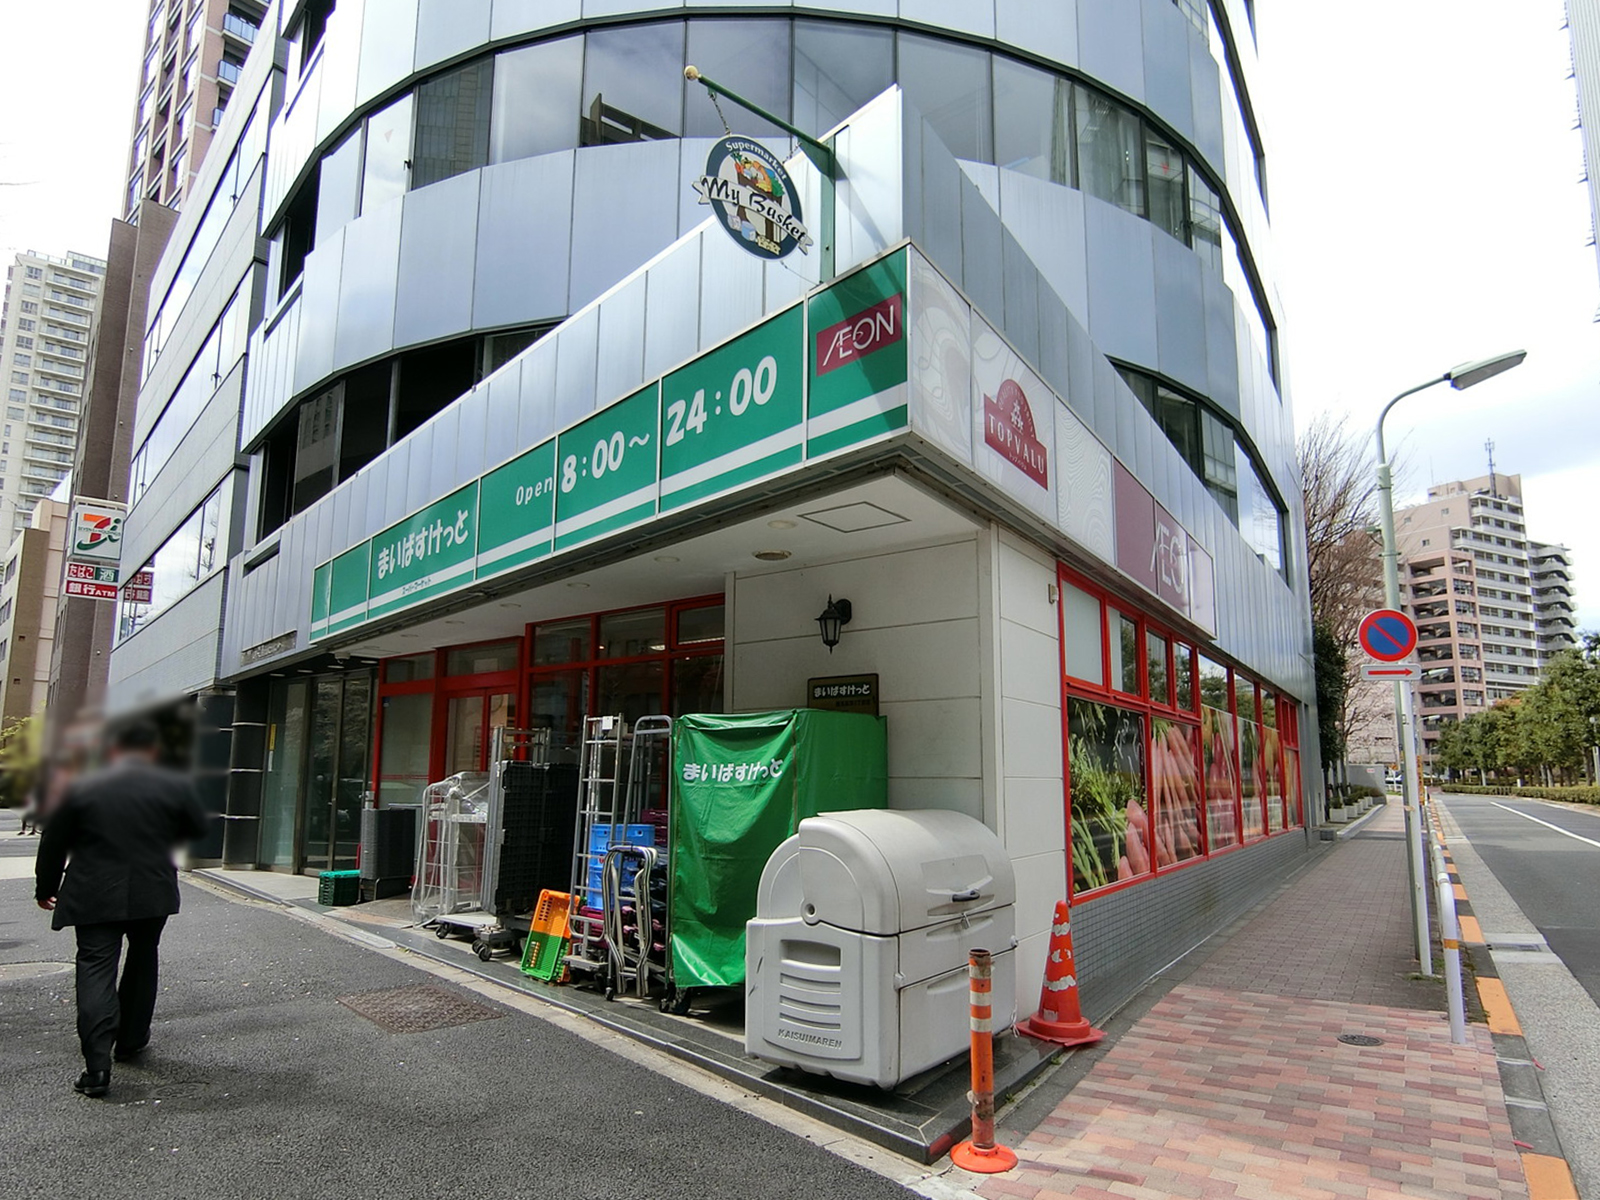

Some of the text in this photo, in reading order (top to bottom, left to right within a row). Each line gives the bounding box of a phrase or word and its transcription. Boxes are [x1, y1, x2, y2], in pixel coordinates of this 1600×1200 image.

[725, 140, 788, 181] Supermarket
[701, 177, 806, 241] My Basket
[515, 477, 553, 506] Open
[666, 355, 777, 447] 24:00
[989, 413, 1044, 474] TOPVALU
[377, 510, 469, 579] まいばすけっと
[69, 564, 94, 579] たばこ
[100, 568, 115, 582] 酒
[813, 684, 871, 698] まいばすけっと
[682, 758, 784, 782] まいばすけっと
[778, 1028, 843, 1049] KAISUIMAREN
